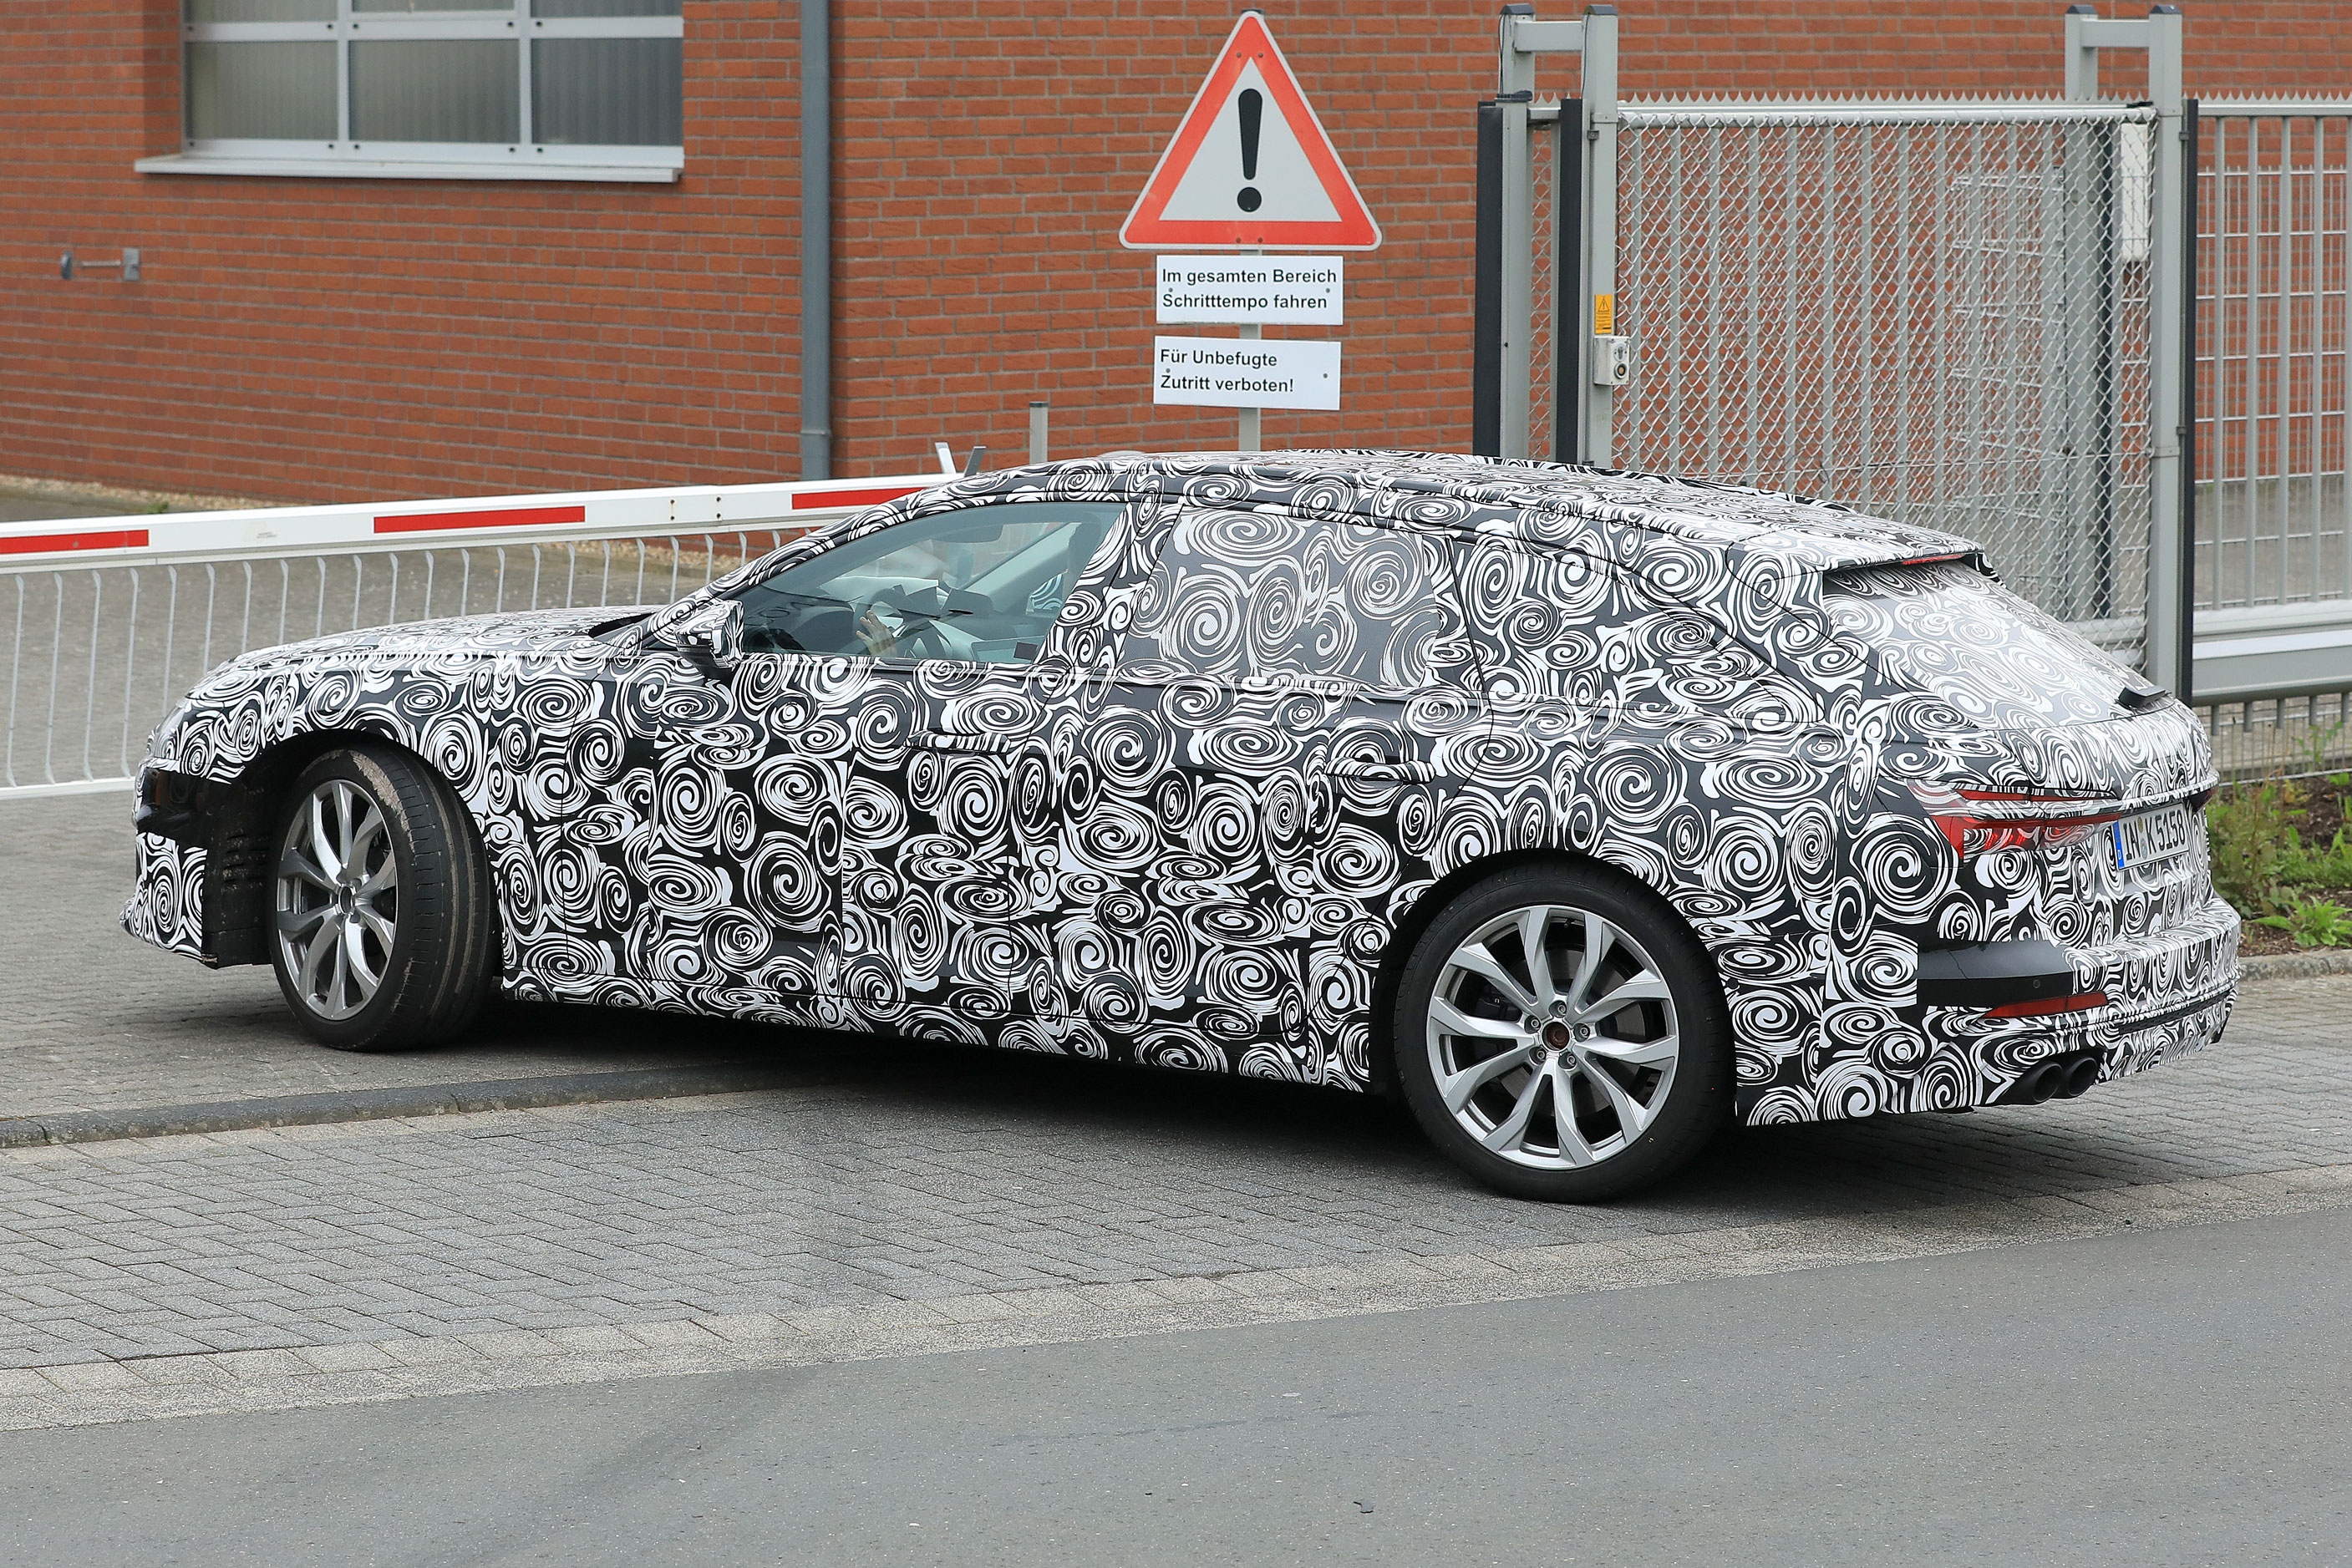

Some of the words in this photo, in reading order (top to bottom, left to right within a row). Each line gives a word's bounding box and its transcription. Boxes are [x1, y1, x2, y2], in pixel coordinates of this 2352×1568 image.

[1162, 268, 1181, 282] Im
[1186, 270, 1267, 286] gesamten
[1273, 268, 1337, 283] Bereich
[1162, 293, 1268, 312] Schritttempo
[1273, 294, 1327, 309] fahren
[1161, 348, 1188, 363] Für
[1192, 349, 1278, 369] Unbefugte
[1161, 374, 1211, 390] Zutritt
[1215, 377, 1293, 393] verboten!
[2123, 820, 2141, 860] IN
[2155, 809, 2186, 851] 5158
